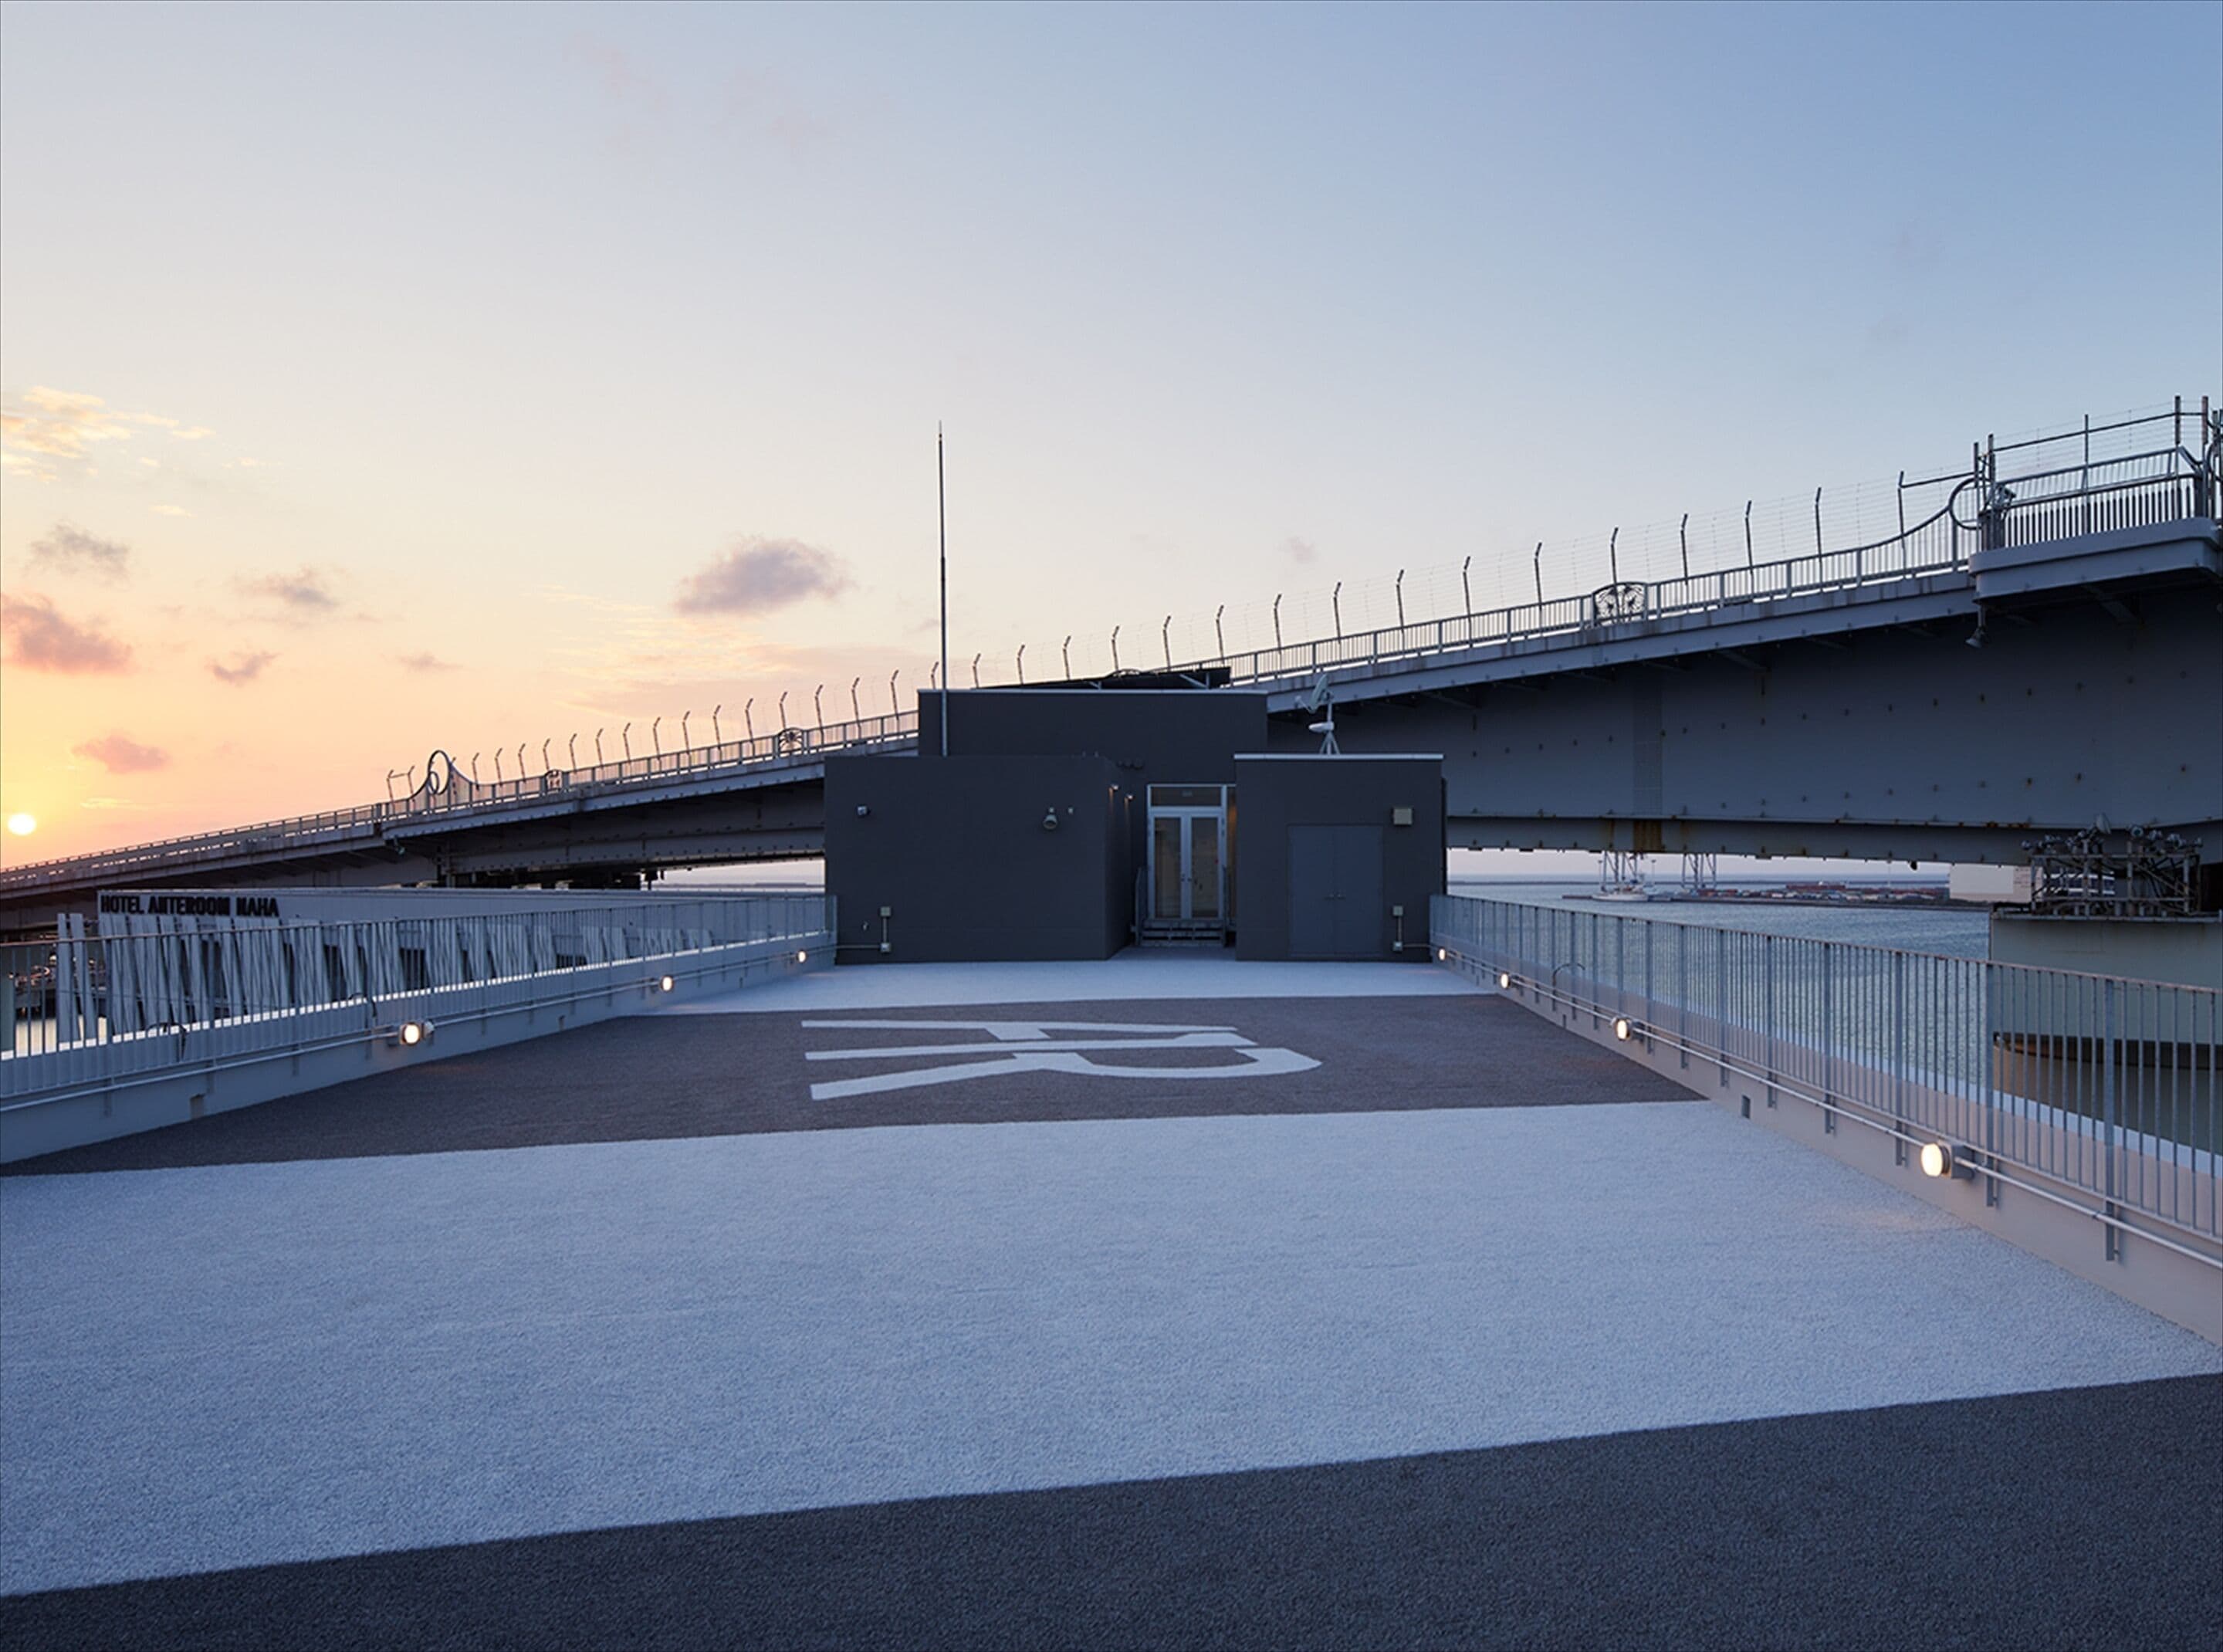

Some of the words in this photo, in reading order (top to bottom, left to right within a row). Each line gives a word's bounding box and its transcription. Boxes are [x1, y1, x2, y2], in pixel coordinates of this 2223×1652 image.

[100, 895, 144, 914] HOTEL
[148, 895, 230, 916] ANTEROOM
[236, 897, 279, 917] NAHA
